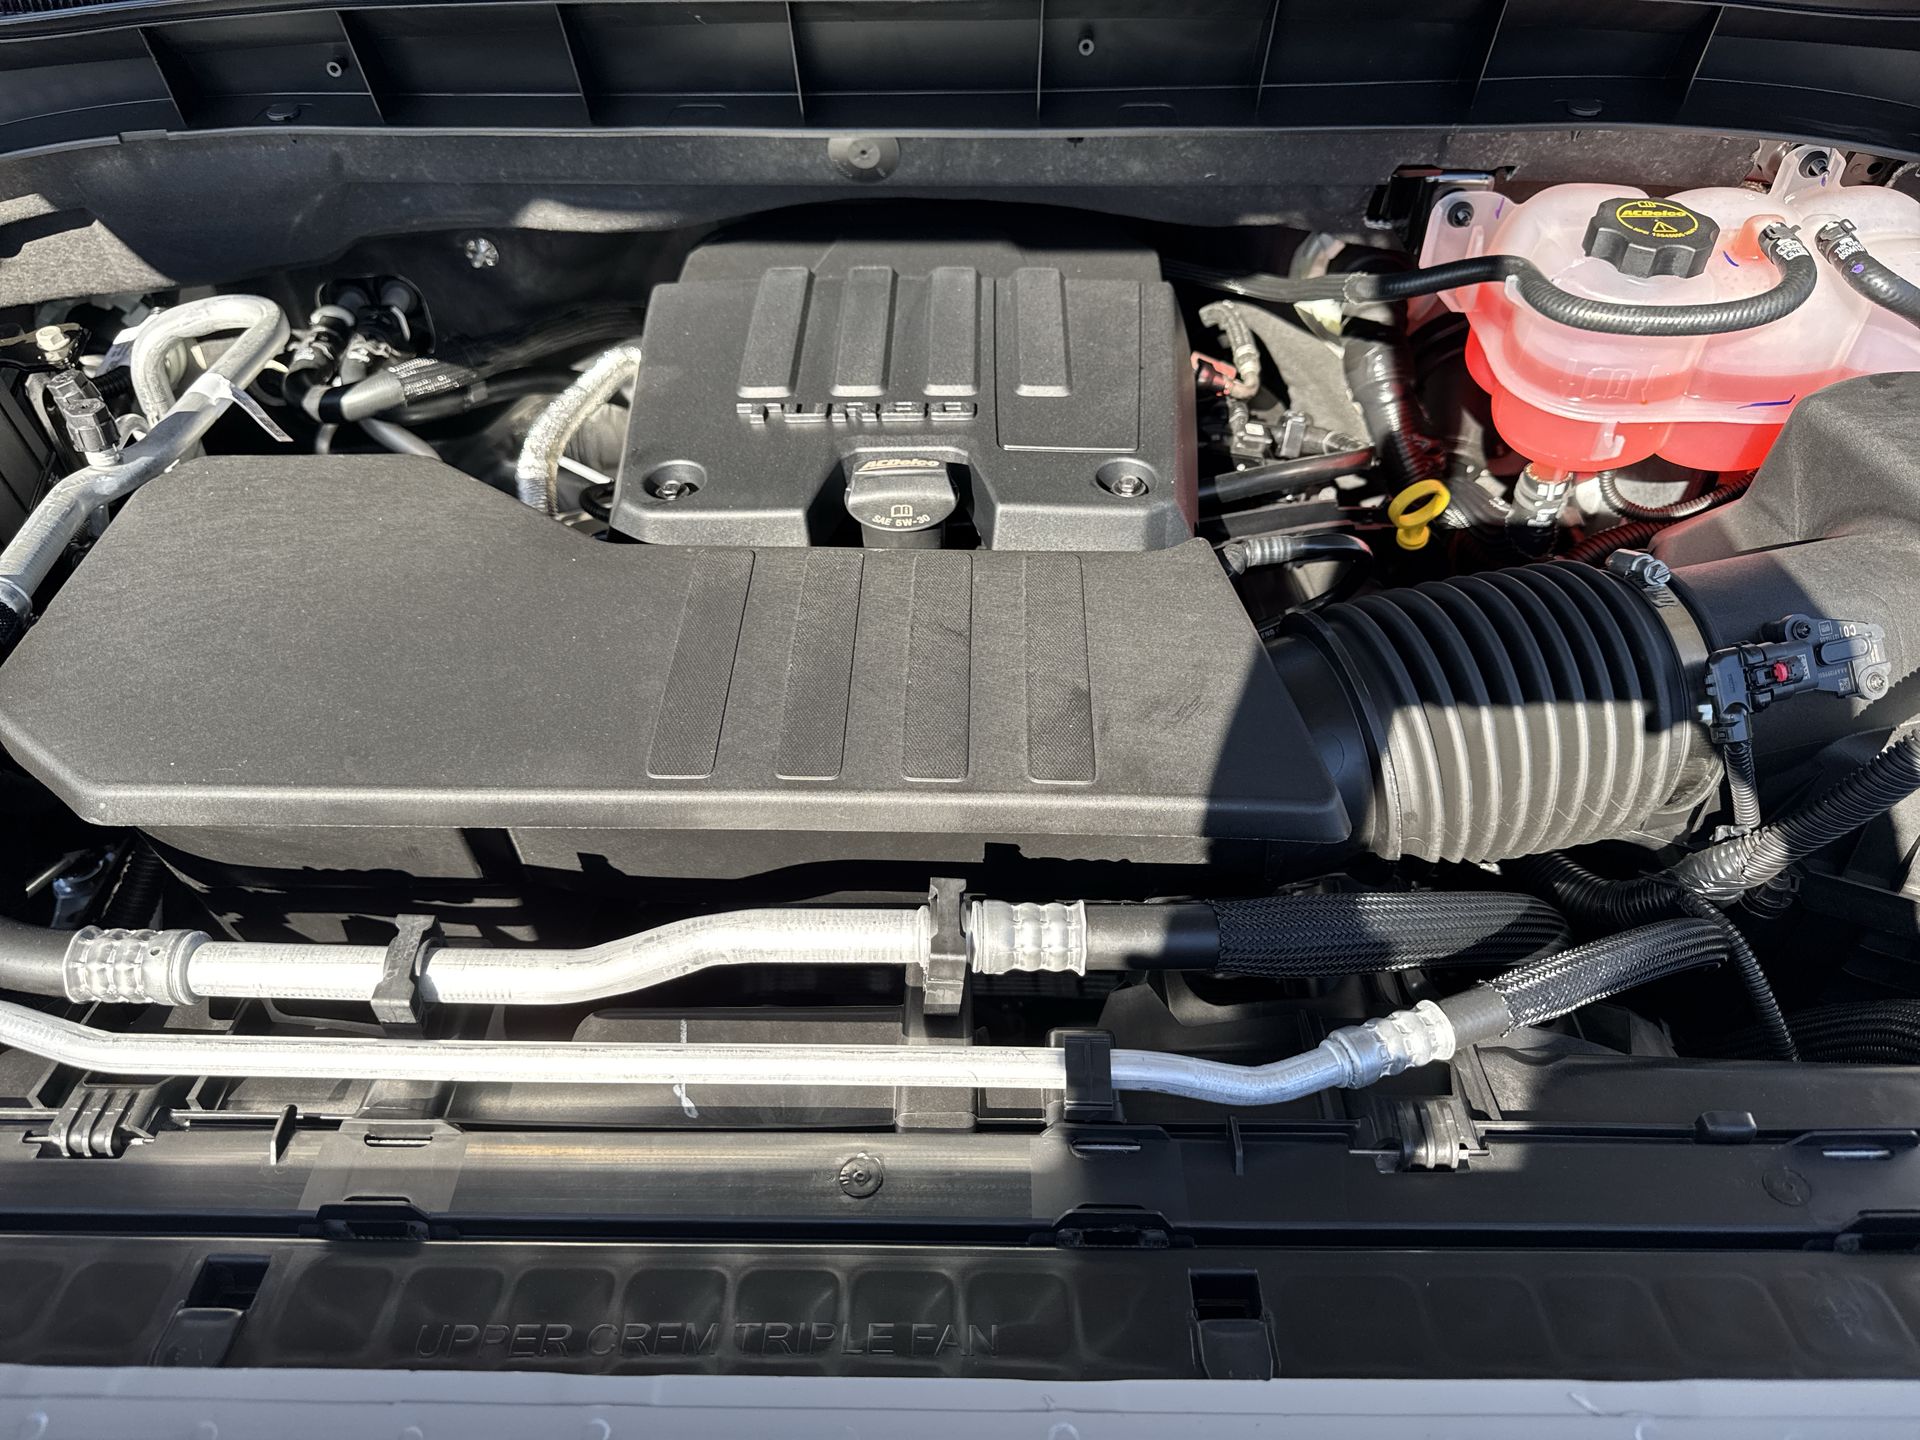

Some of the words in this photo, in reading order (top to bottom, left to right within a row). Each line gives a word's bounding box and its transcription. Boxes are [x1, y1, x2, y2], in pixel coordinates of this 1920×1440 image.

[1620, 209, 1687, 218] ACDelco
[736, 402, 977, 424] TURBO
[858, 459, 940, 472] ACDelco
[871, 514, 893, 526] SAE
[415, 1323, 573, 1358] UPPER
[734, 1322, 895, 1357] TRIPLE
[911, 1323, 999, 1358] FAN
